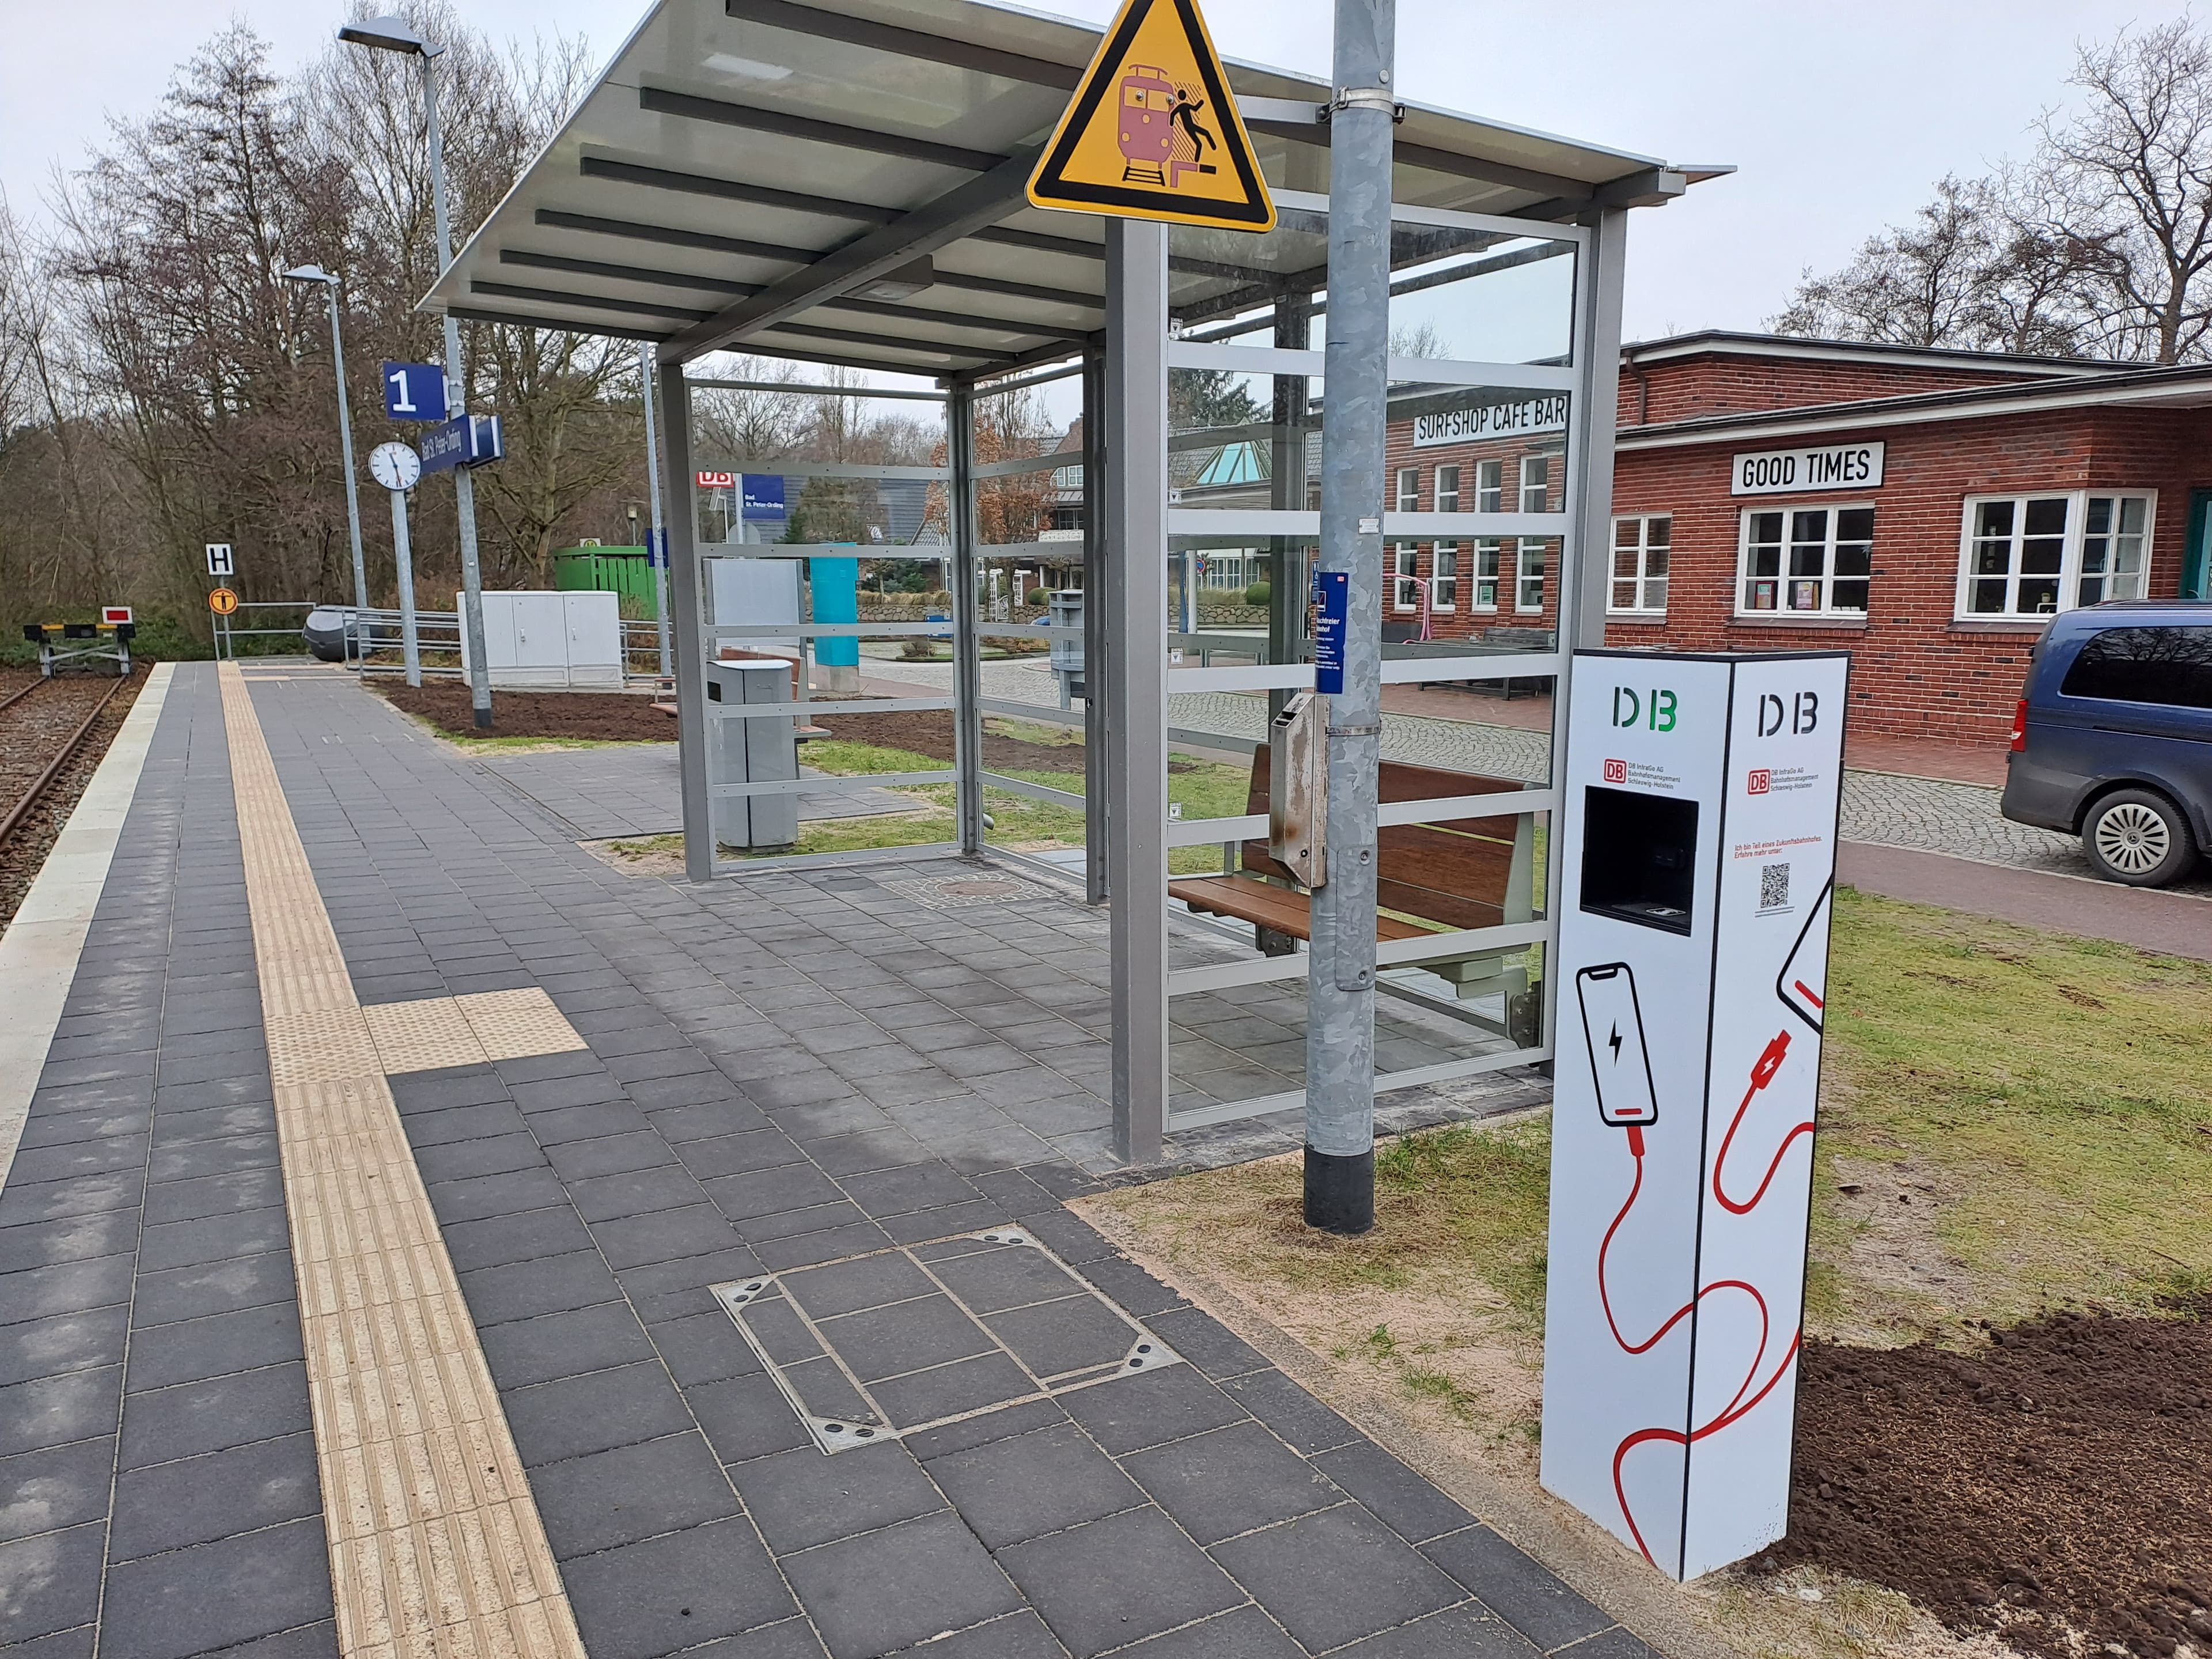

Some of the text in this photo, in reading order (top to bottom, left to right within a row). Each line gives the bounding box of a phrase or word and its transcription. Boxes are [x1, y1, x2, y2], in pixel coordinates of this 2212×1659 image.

[389, 370, 416, 411] 1
[1419, 397, 1565, 440] SURFSHOP CAFE BAR
[701, 471, 729, 483] DB
[1743, 449, 1870, 487] GOOD TIMES
[210, 548, 230, 571] H
[1613, 686, 1677, 732] DB
[1758, 691, 1819, 737] DB
[1606, 762, 1624, 780] DB
[1750, 772, 1768, 791] DB
[1628, 778, 1674, 790] Schleswig-Holstein
[1770, 782, 1813, 791] Schleswig-Holstein
